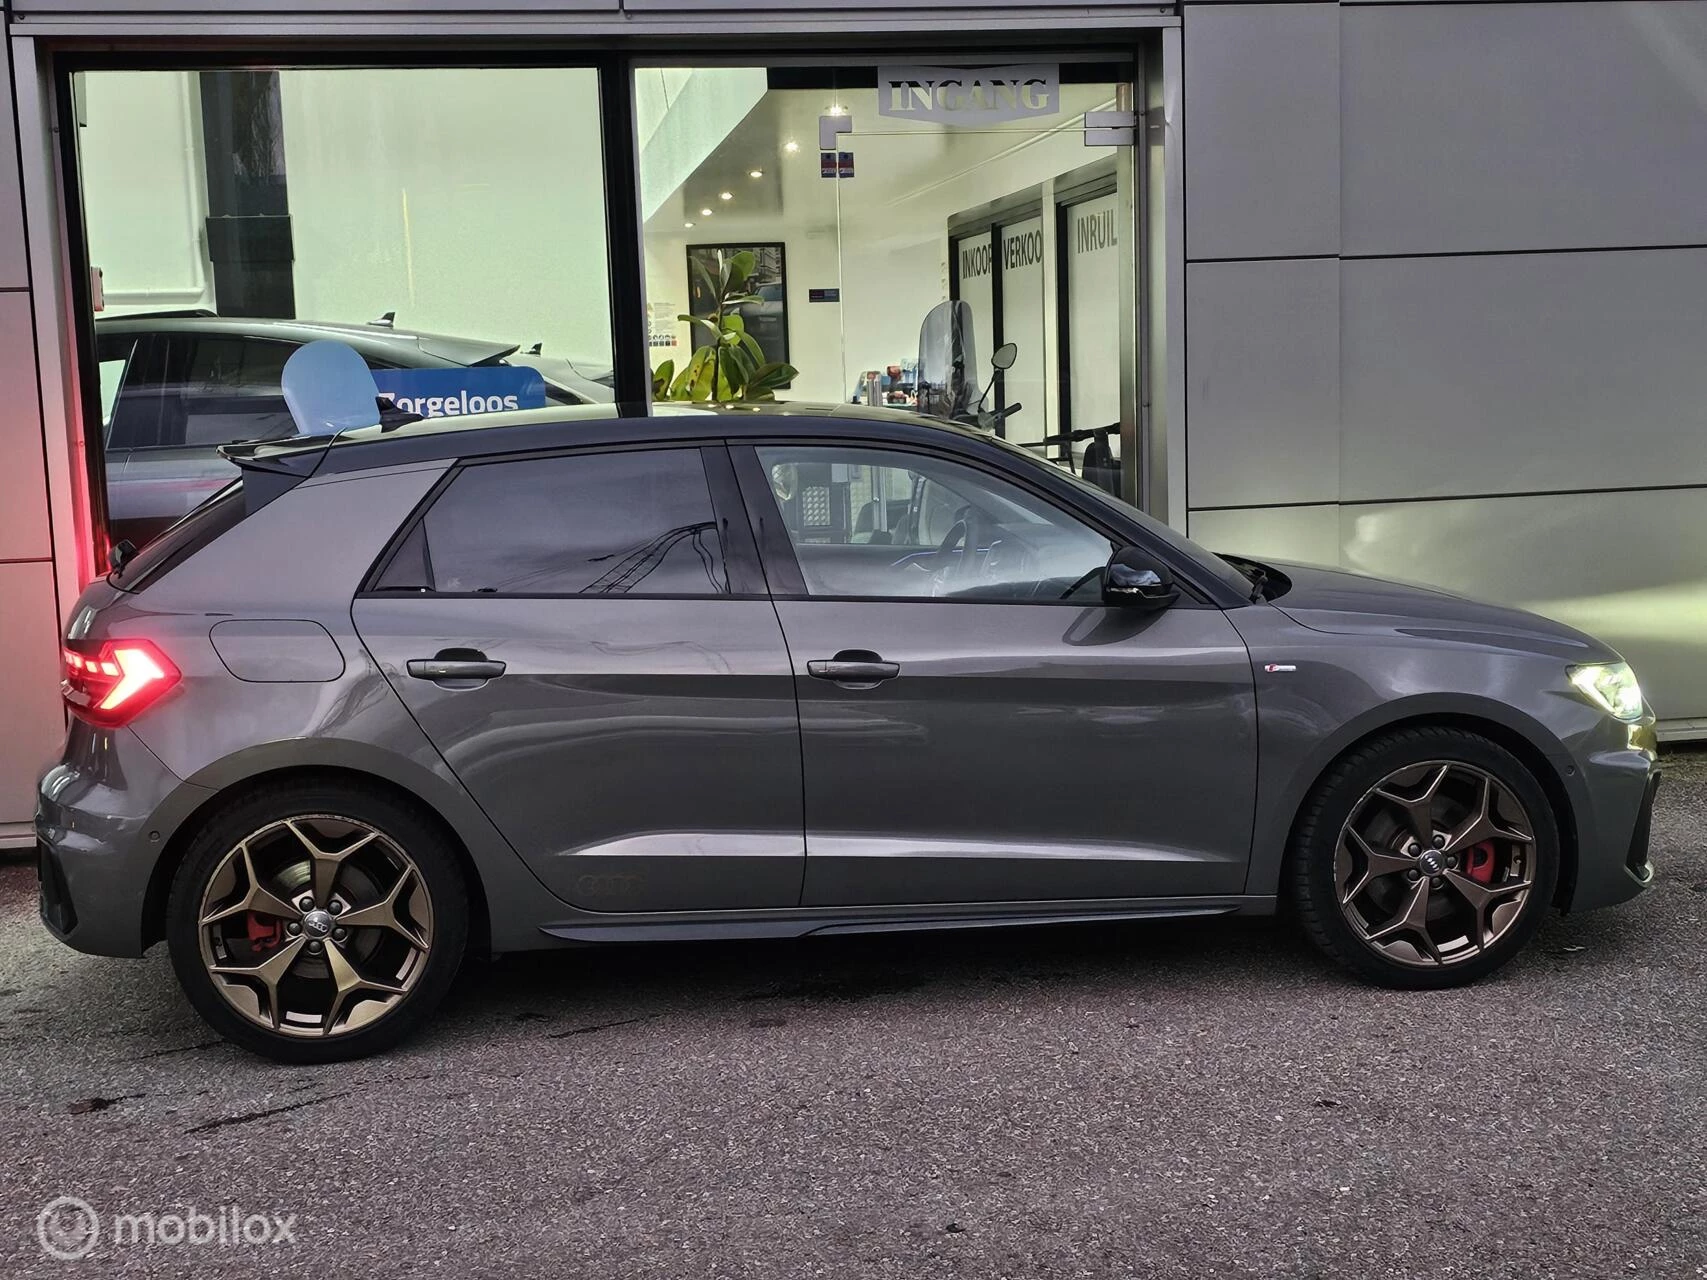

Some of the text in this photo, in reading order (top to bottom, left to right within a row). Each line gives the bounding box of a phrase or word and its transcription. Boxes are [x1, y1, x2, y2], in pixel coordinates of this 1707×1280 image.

[888, 79, 1049, 111] INGANG
[1003, 229, 1043, 270] VERKOO
[1077, 208, 1118, 254] INRUIL
